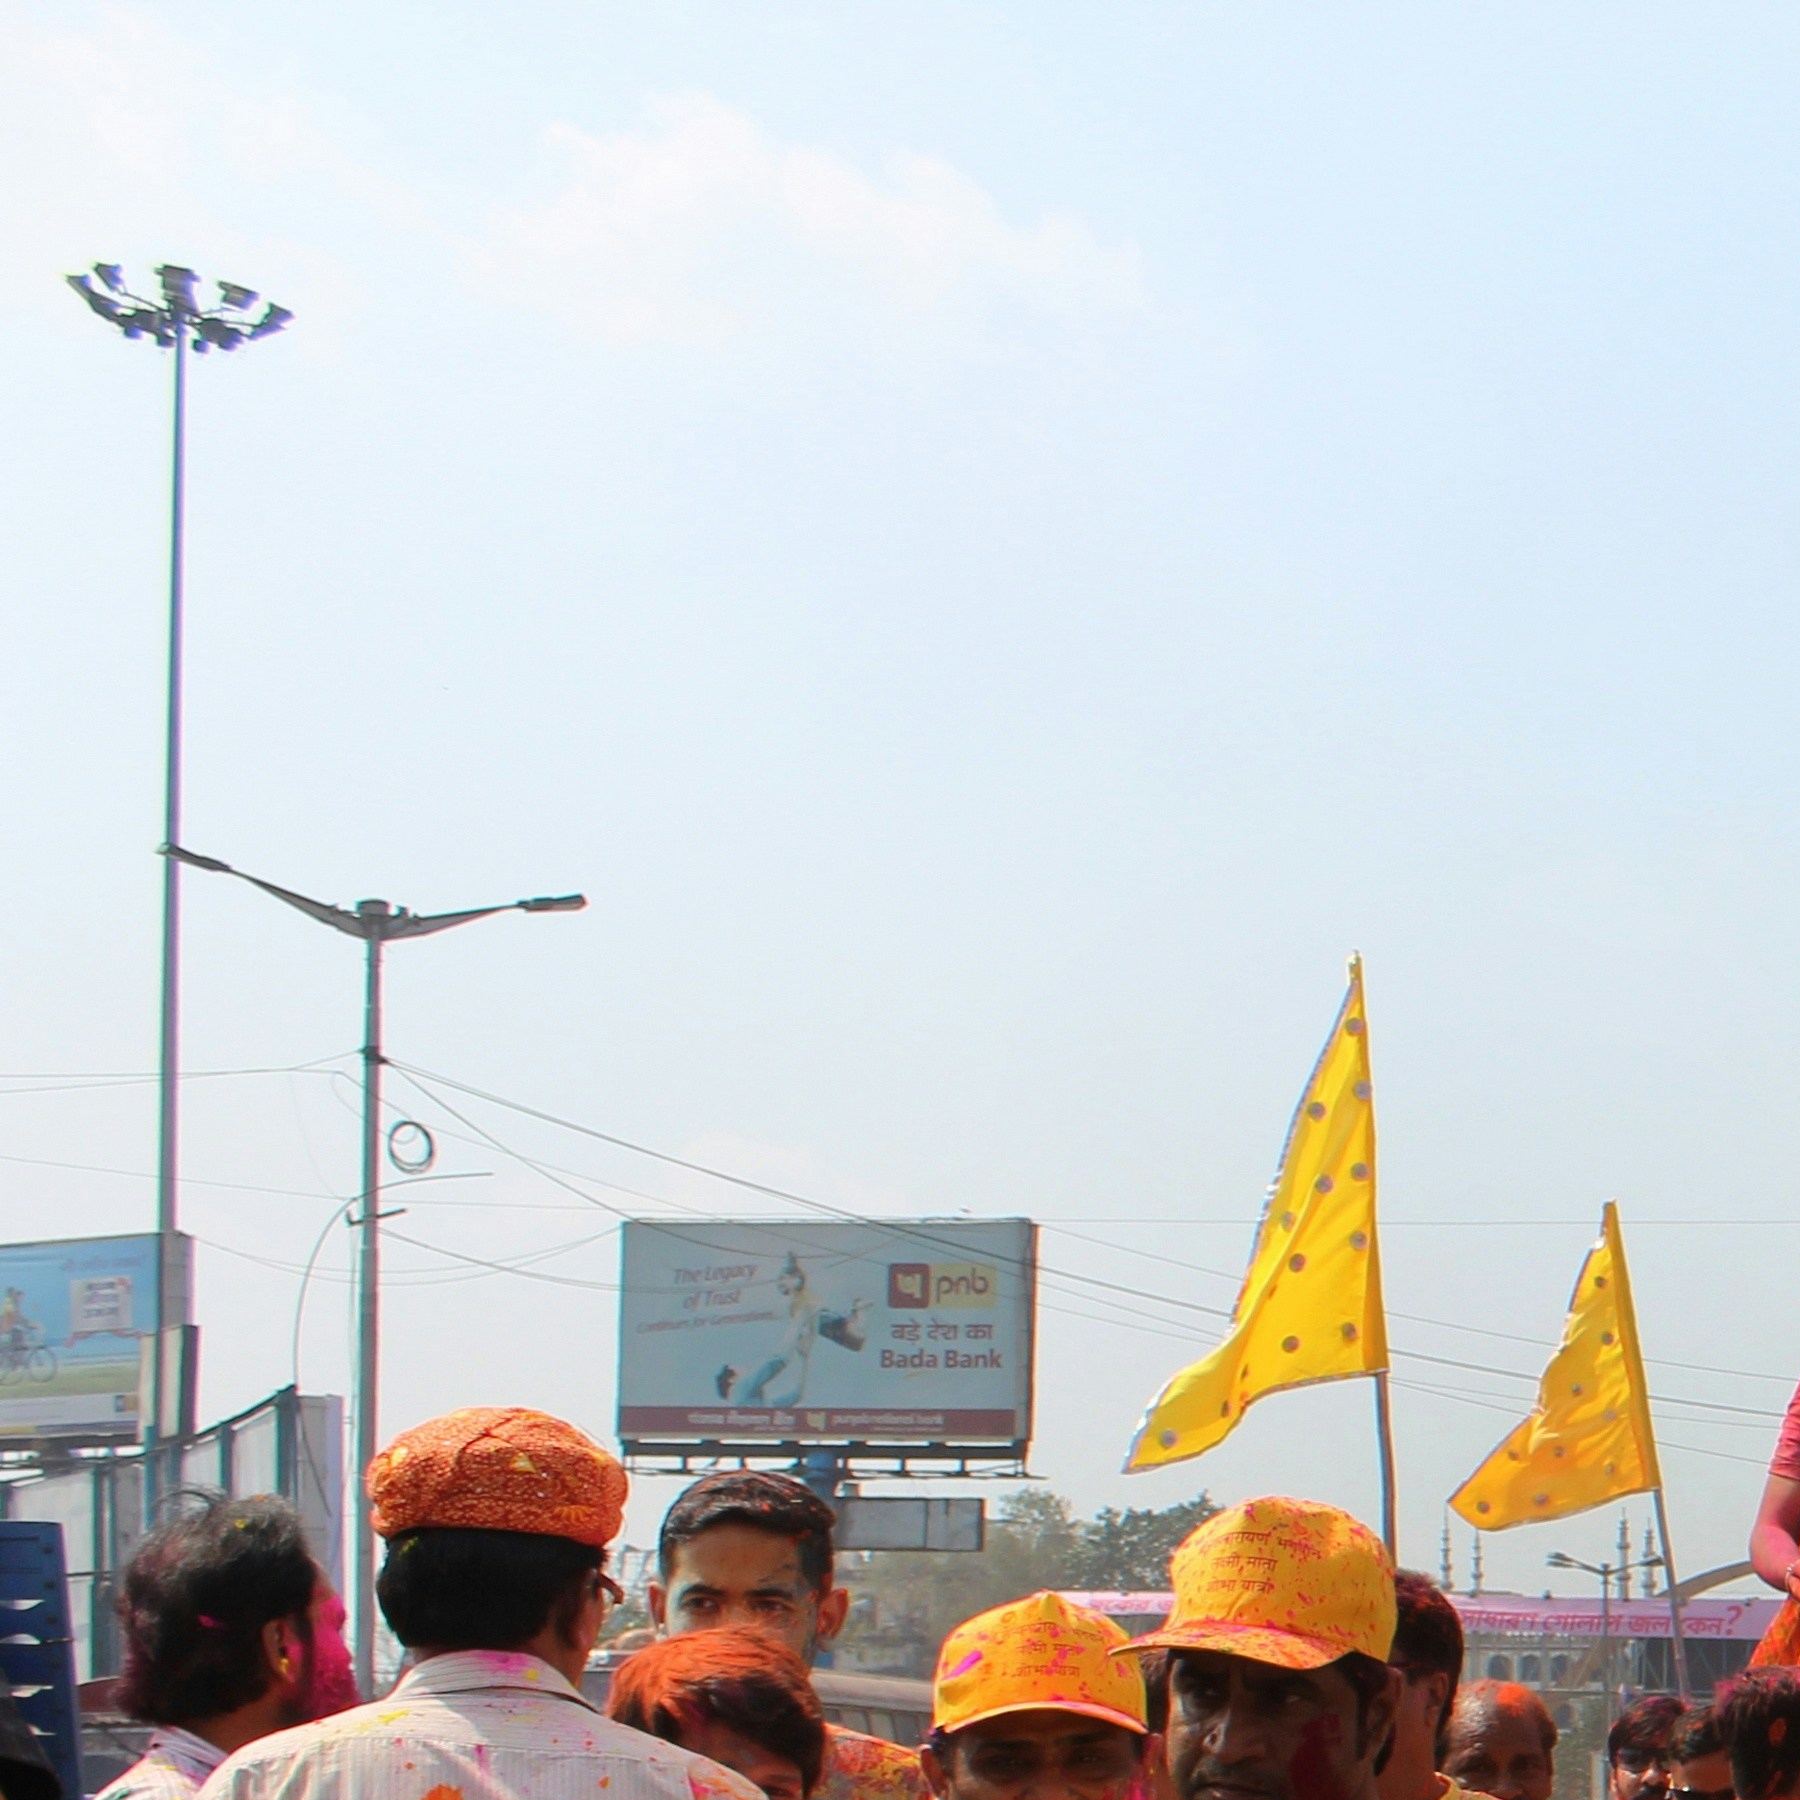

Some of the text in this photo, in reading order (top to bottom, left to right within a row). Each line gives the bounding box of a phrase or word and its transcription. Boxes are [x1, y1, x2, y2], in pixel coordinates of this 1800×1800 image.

[936, 1267, 990, 1304] pnb
[964, 1323, 993, 1340] का
[880, 1347, 1003, 1369] Bada Bank
